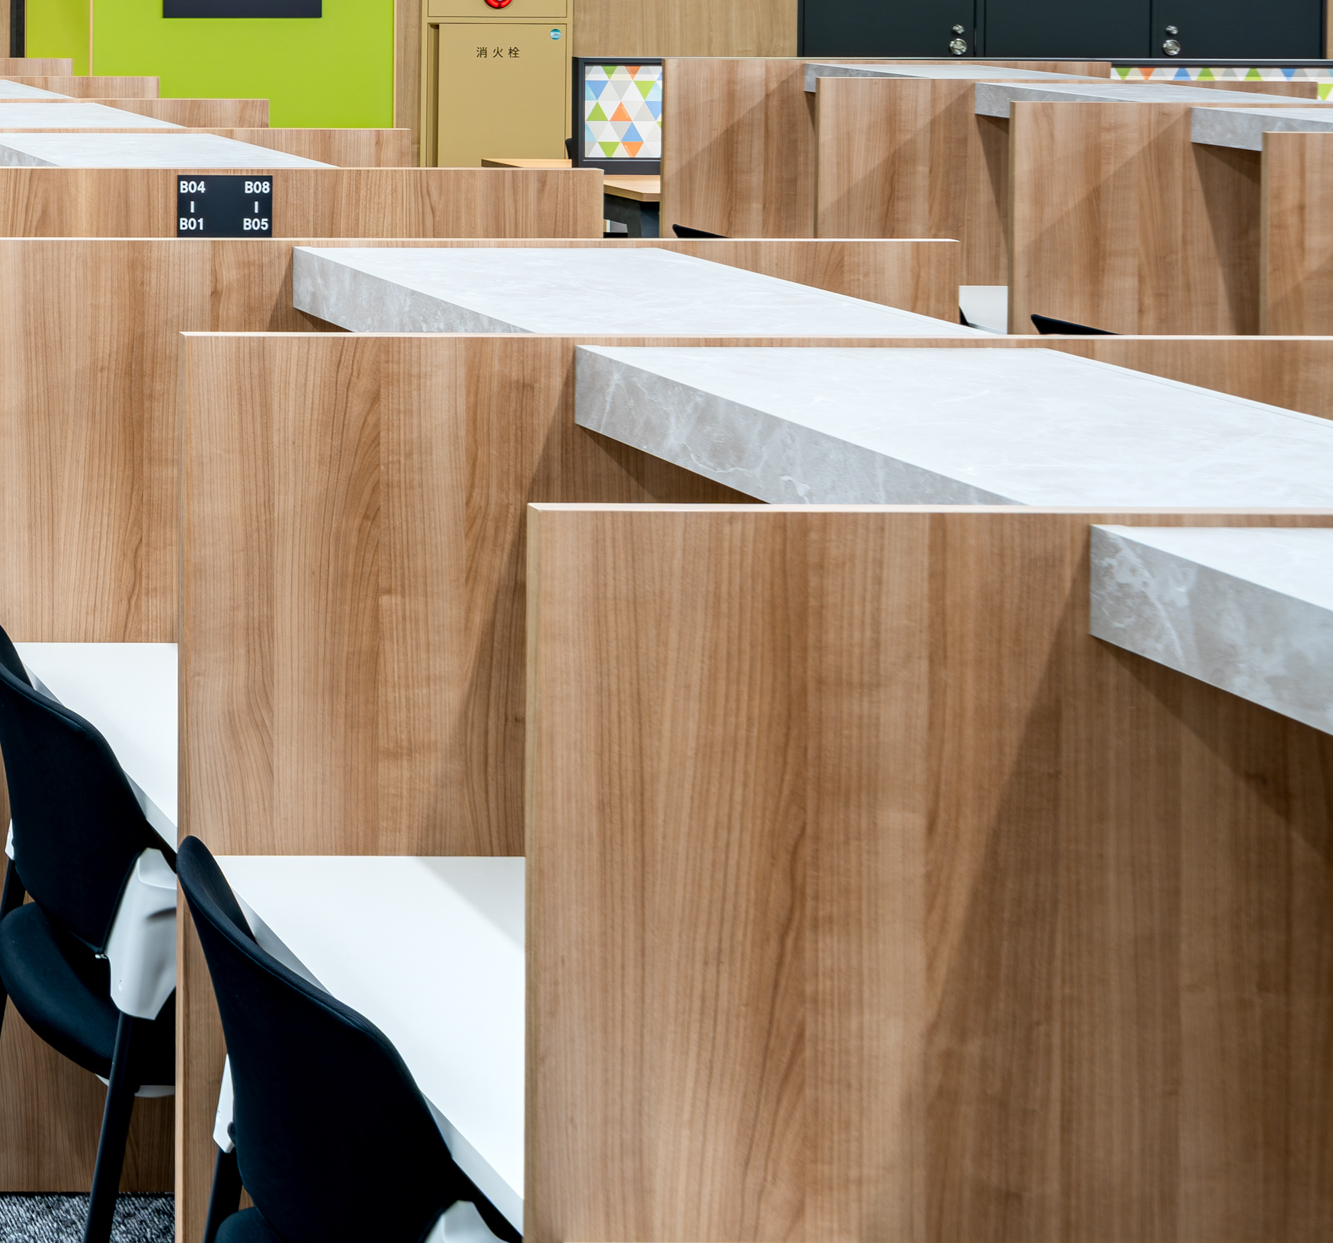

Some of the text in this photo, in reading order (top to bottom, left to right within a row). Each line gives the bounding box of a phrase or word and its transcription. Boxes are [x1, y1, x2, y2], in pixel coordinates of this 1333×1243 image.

[476, 46, 520, 58] 消火栓
[180, 180, 206, 193] B04
[244, 181, 270, 194] B08
[179, 217, 204, 230] B01
[243, 218, 269, 231] B05
